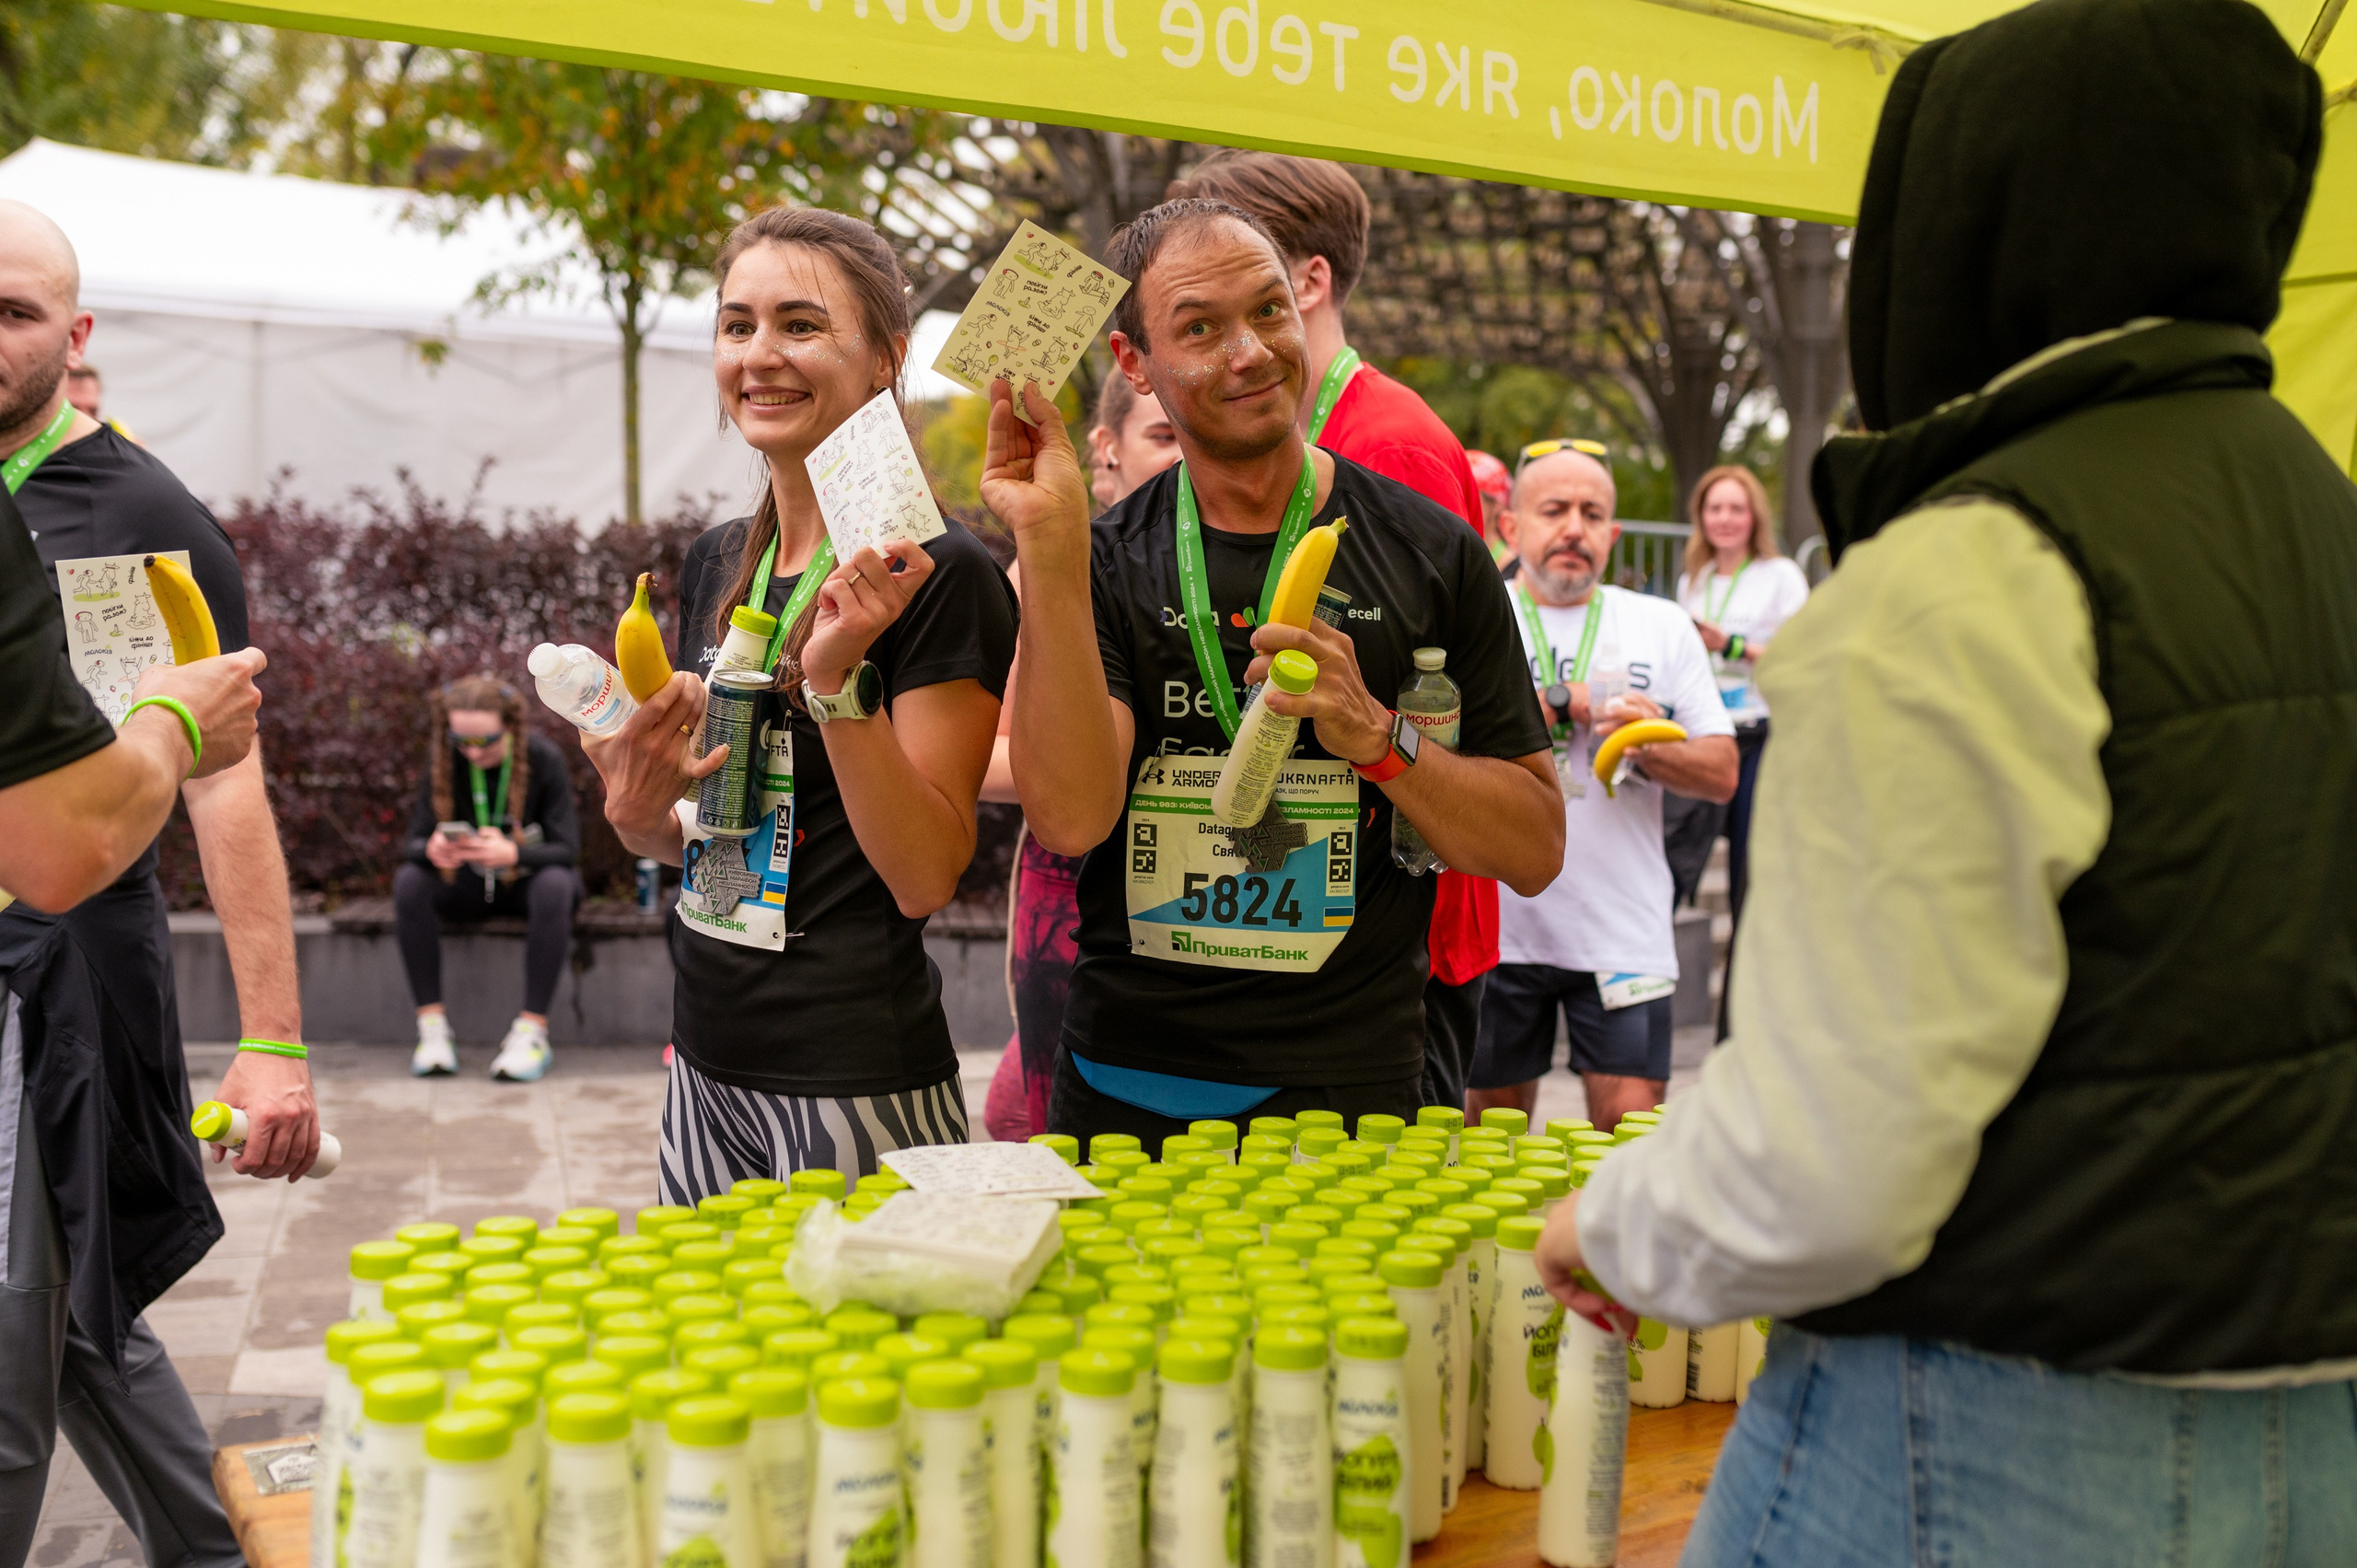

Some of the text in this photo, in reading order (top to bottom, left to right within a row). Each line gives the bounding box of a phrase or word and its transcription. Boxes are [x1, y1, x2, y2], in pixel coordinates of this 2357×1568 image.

[1348, 608, 1381, 621] ecell
[581, 664, 612, 717] моршин
[1406, 710, 1460, 727] моршинс
[1172, 770, 1222, 779] UNDER
[1171, 779, 1218, 788] ARMO
[1179, 801, 1213, 810] КИЇВСЬ
[1198, 822, 1231, 838] Datag
[1181, 872, 1303, 927] 5824
[685, 907, 747, 933] ПриватБанк
[1192, 940, 1308, 960] ПриватБанк
